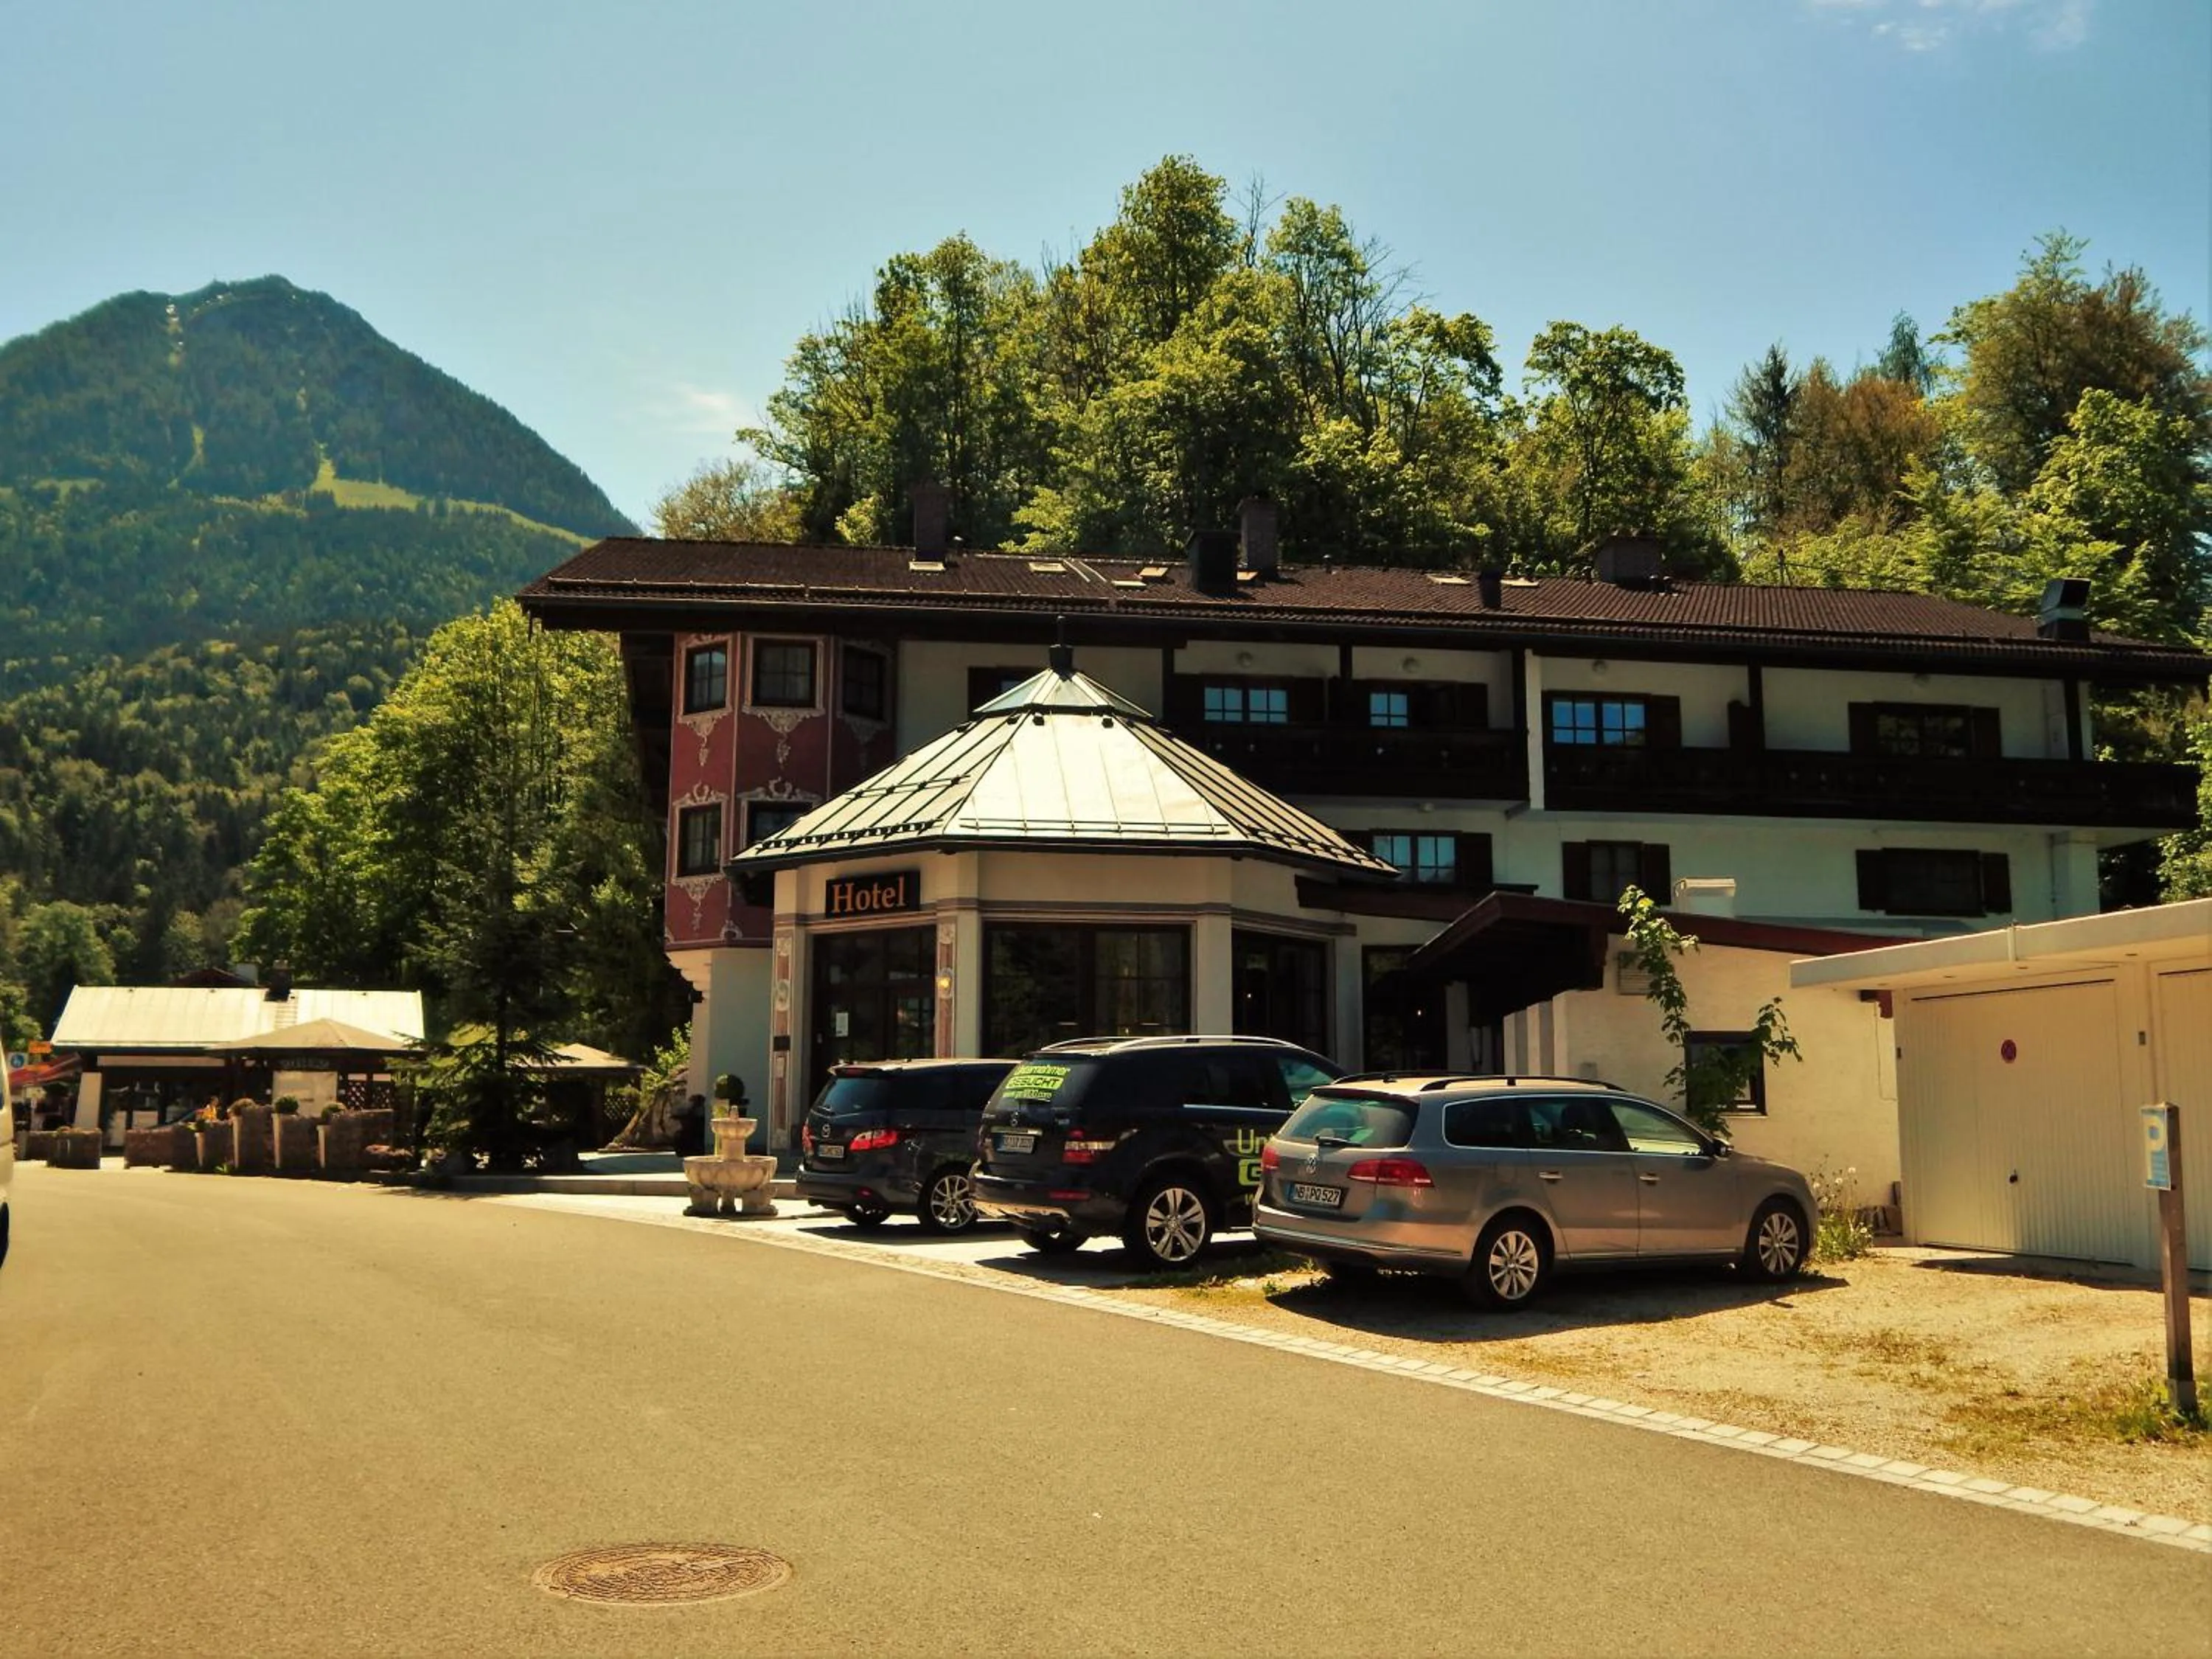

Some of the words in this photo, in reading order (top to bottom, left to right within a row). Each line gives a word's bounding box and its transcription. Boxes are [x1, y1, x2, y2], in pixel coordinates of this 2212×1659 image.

[831, 875, 907, 914] Hotel
[1008, 1077, 1060, 1088] GESUCHT
[2143, 1116, 2166, 1180] P
